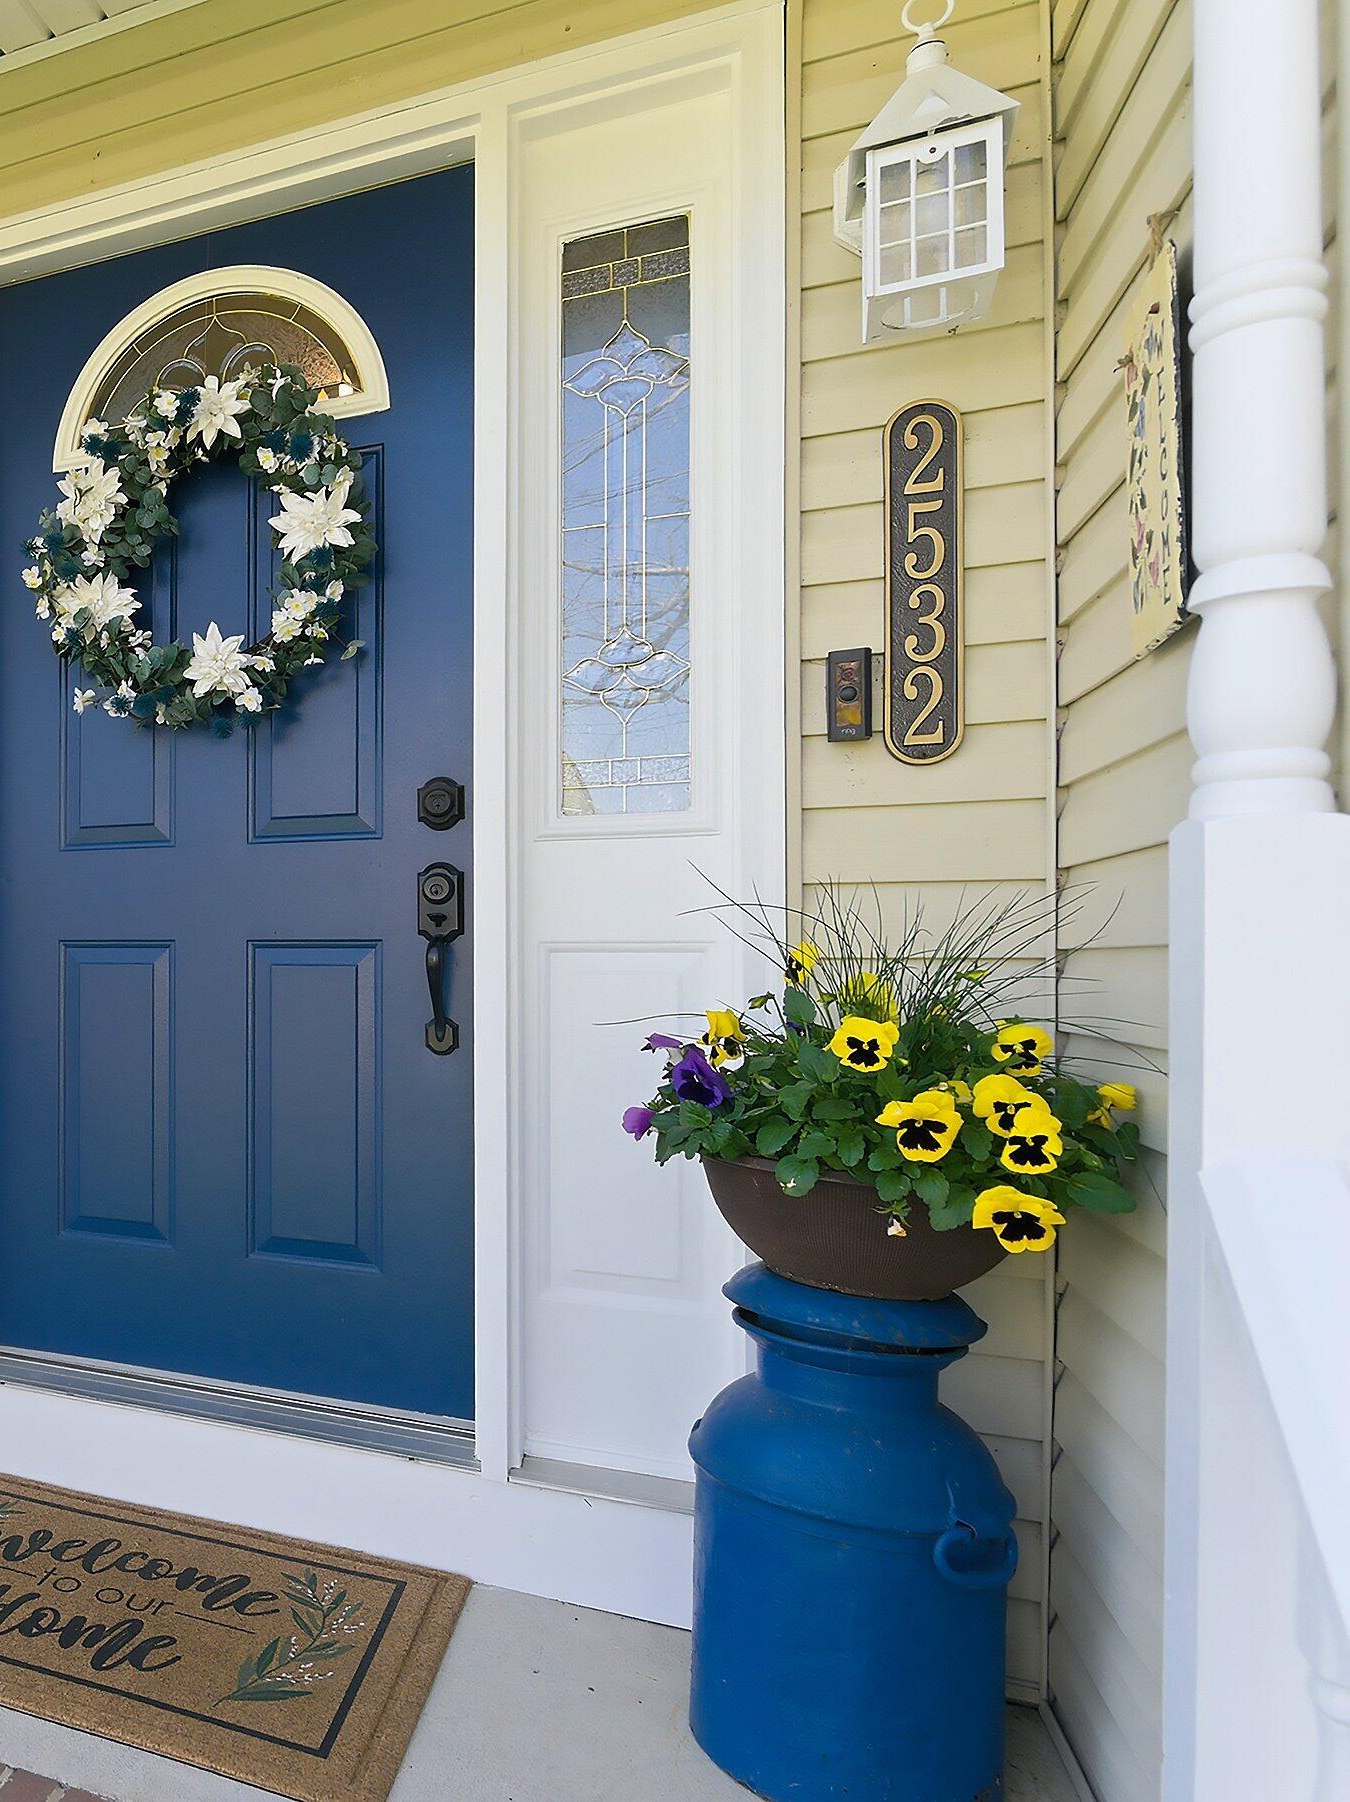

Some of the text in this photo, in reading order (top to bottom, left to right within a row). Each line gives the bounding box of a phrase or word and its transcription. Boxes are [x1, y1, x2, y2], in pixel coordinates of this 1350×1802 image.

[903, 413, 946, 746] 2532
[1153, 318, 1171, 604] WELCOME
[37, 1567, 175, 1616] to our
